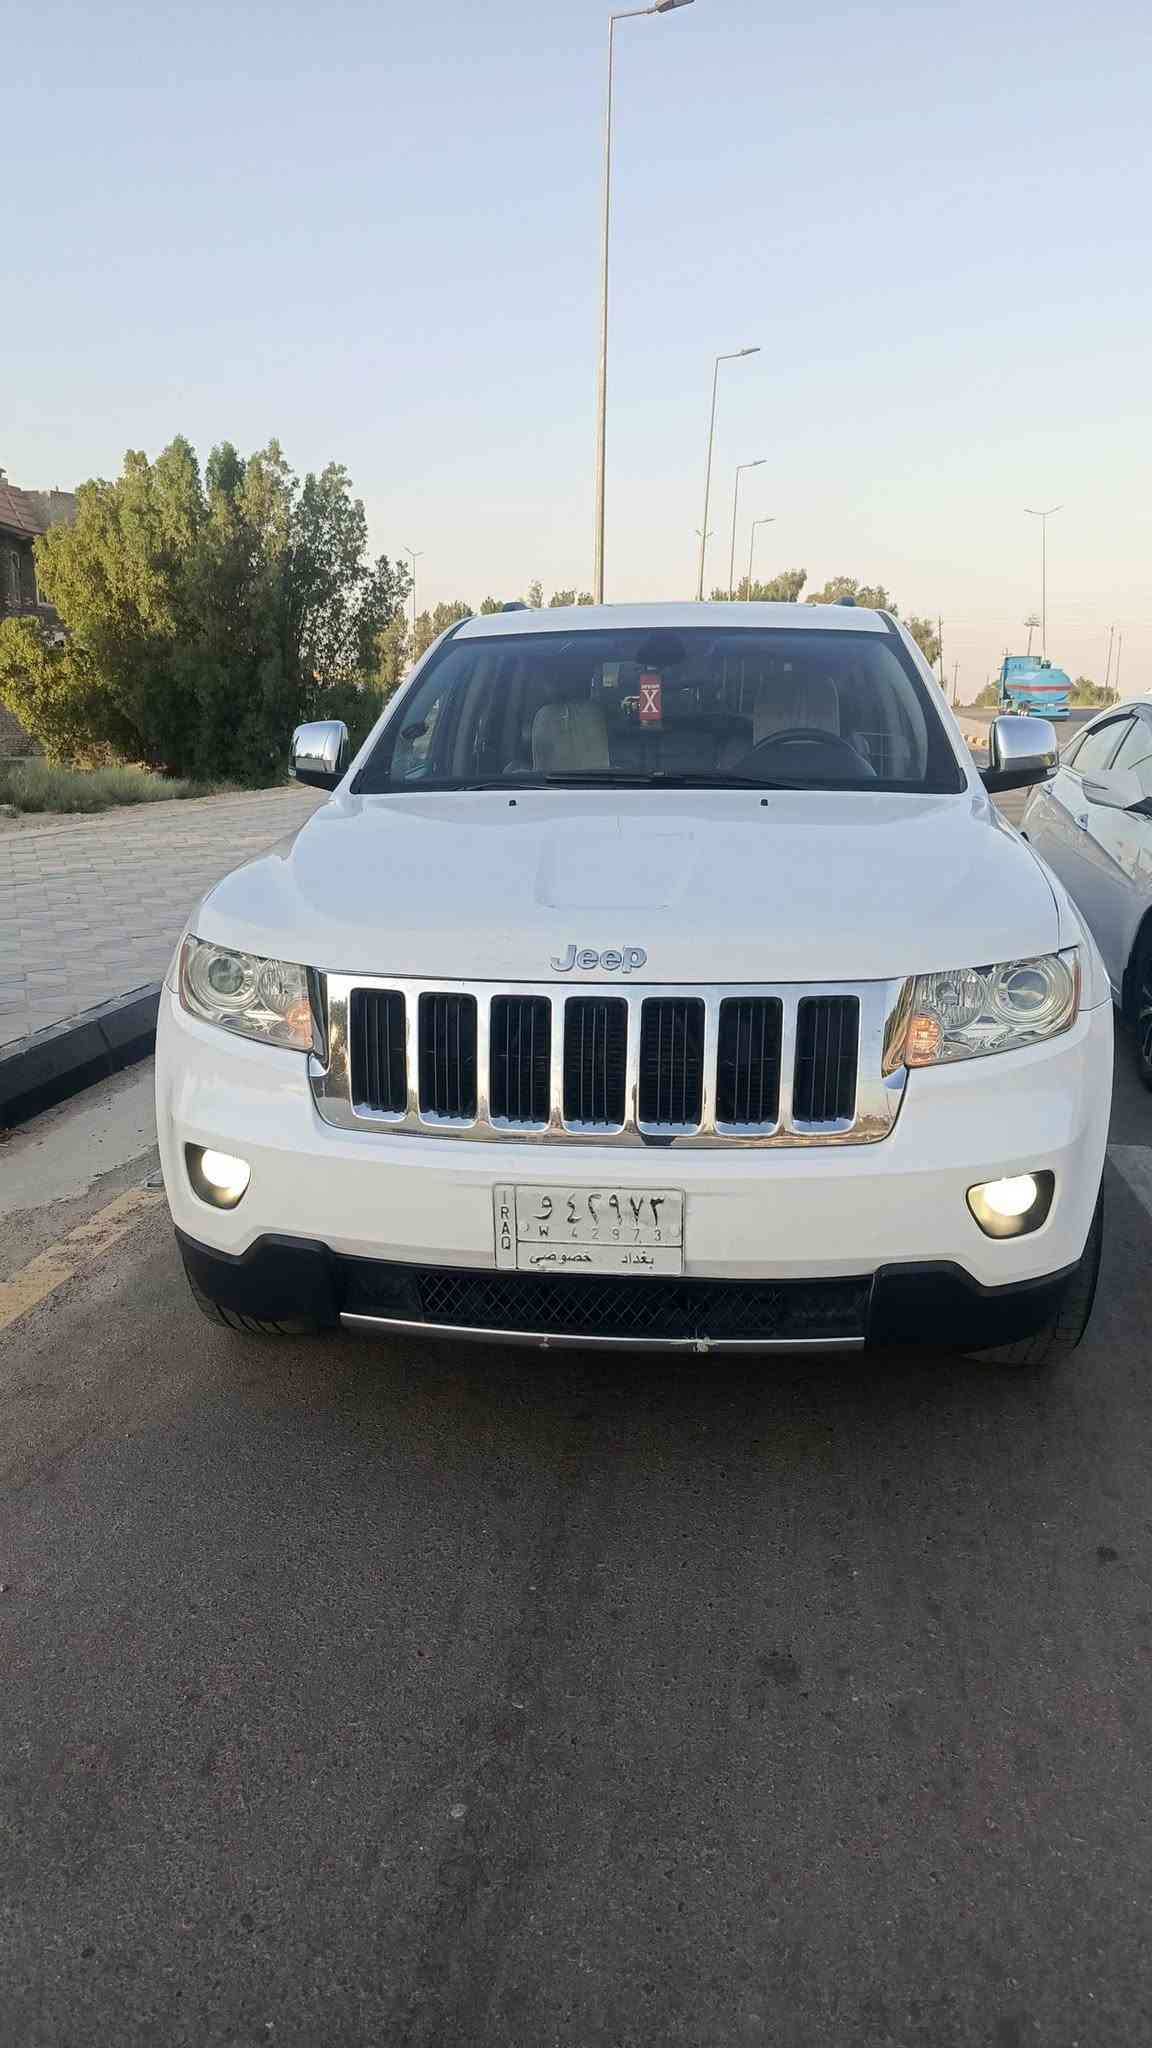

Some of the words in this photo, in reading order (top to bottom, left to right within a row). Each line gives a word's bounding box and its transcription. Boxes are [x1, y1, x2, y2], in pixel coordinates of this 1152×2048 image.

[550, 944, 647, 974] Jeep
[500, 1190, 511, 1250] IRAQ
[529, 1250, 593, 1267] خصوصي
[621, 1250, 655, 1270] بغداد
